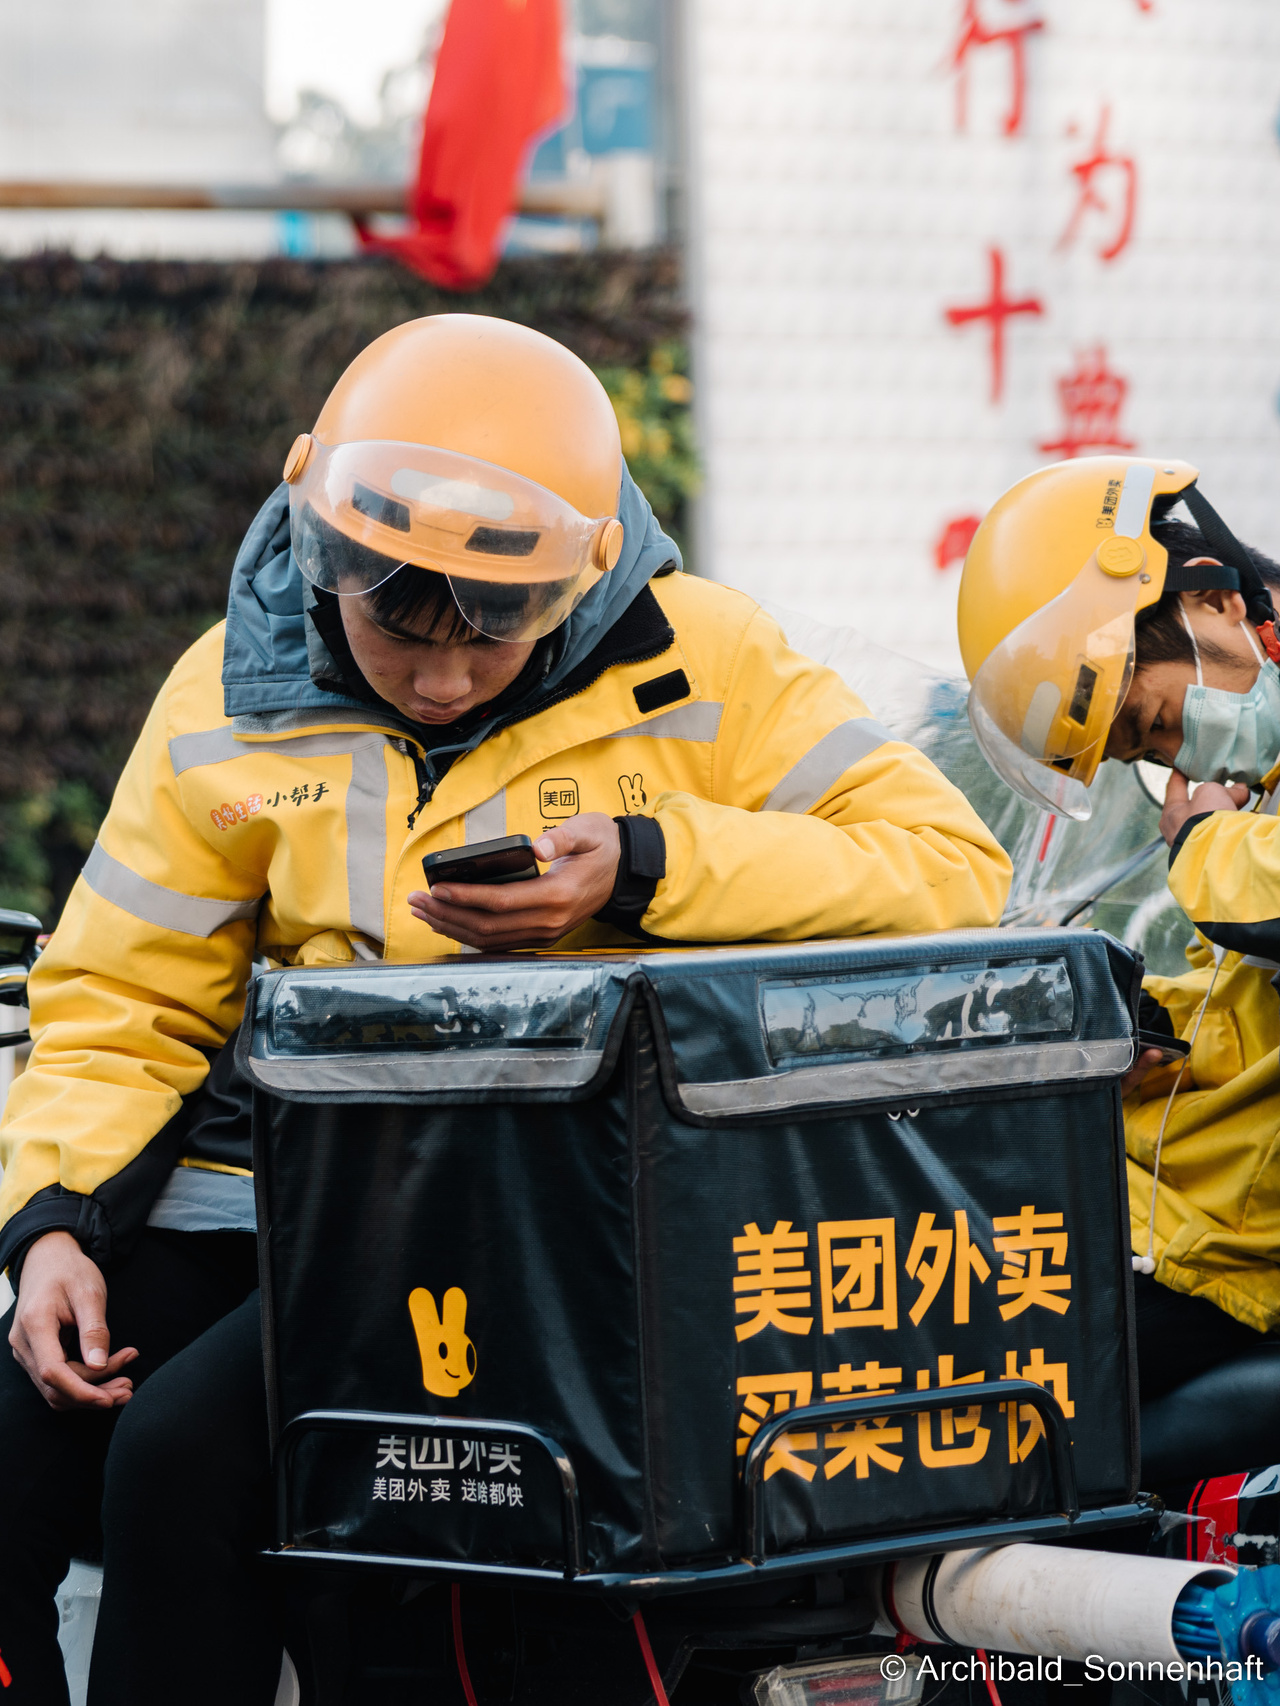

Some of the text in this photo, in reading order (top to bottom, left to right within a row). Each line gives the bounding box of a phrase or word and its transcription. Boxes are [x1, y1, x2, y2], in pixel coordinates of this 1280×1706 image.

[543, 790, 576, 808] 美团
[732, 1205, 1072, 1343] 美团外卖
[372, 1476, 524, 1508] 美团外卖 送啥都快
